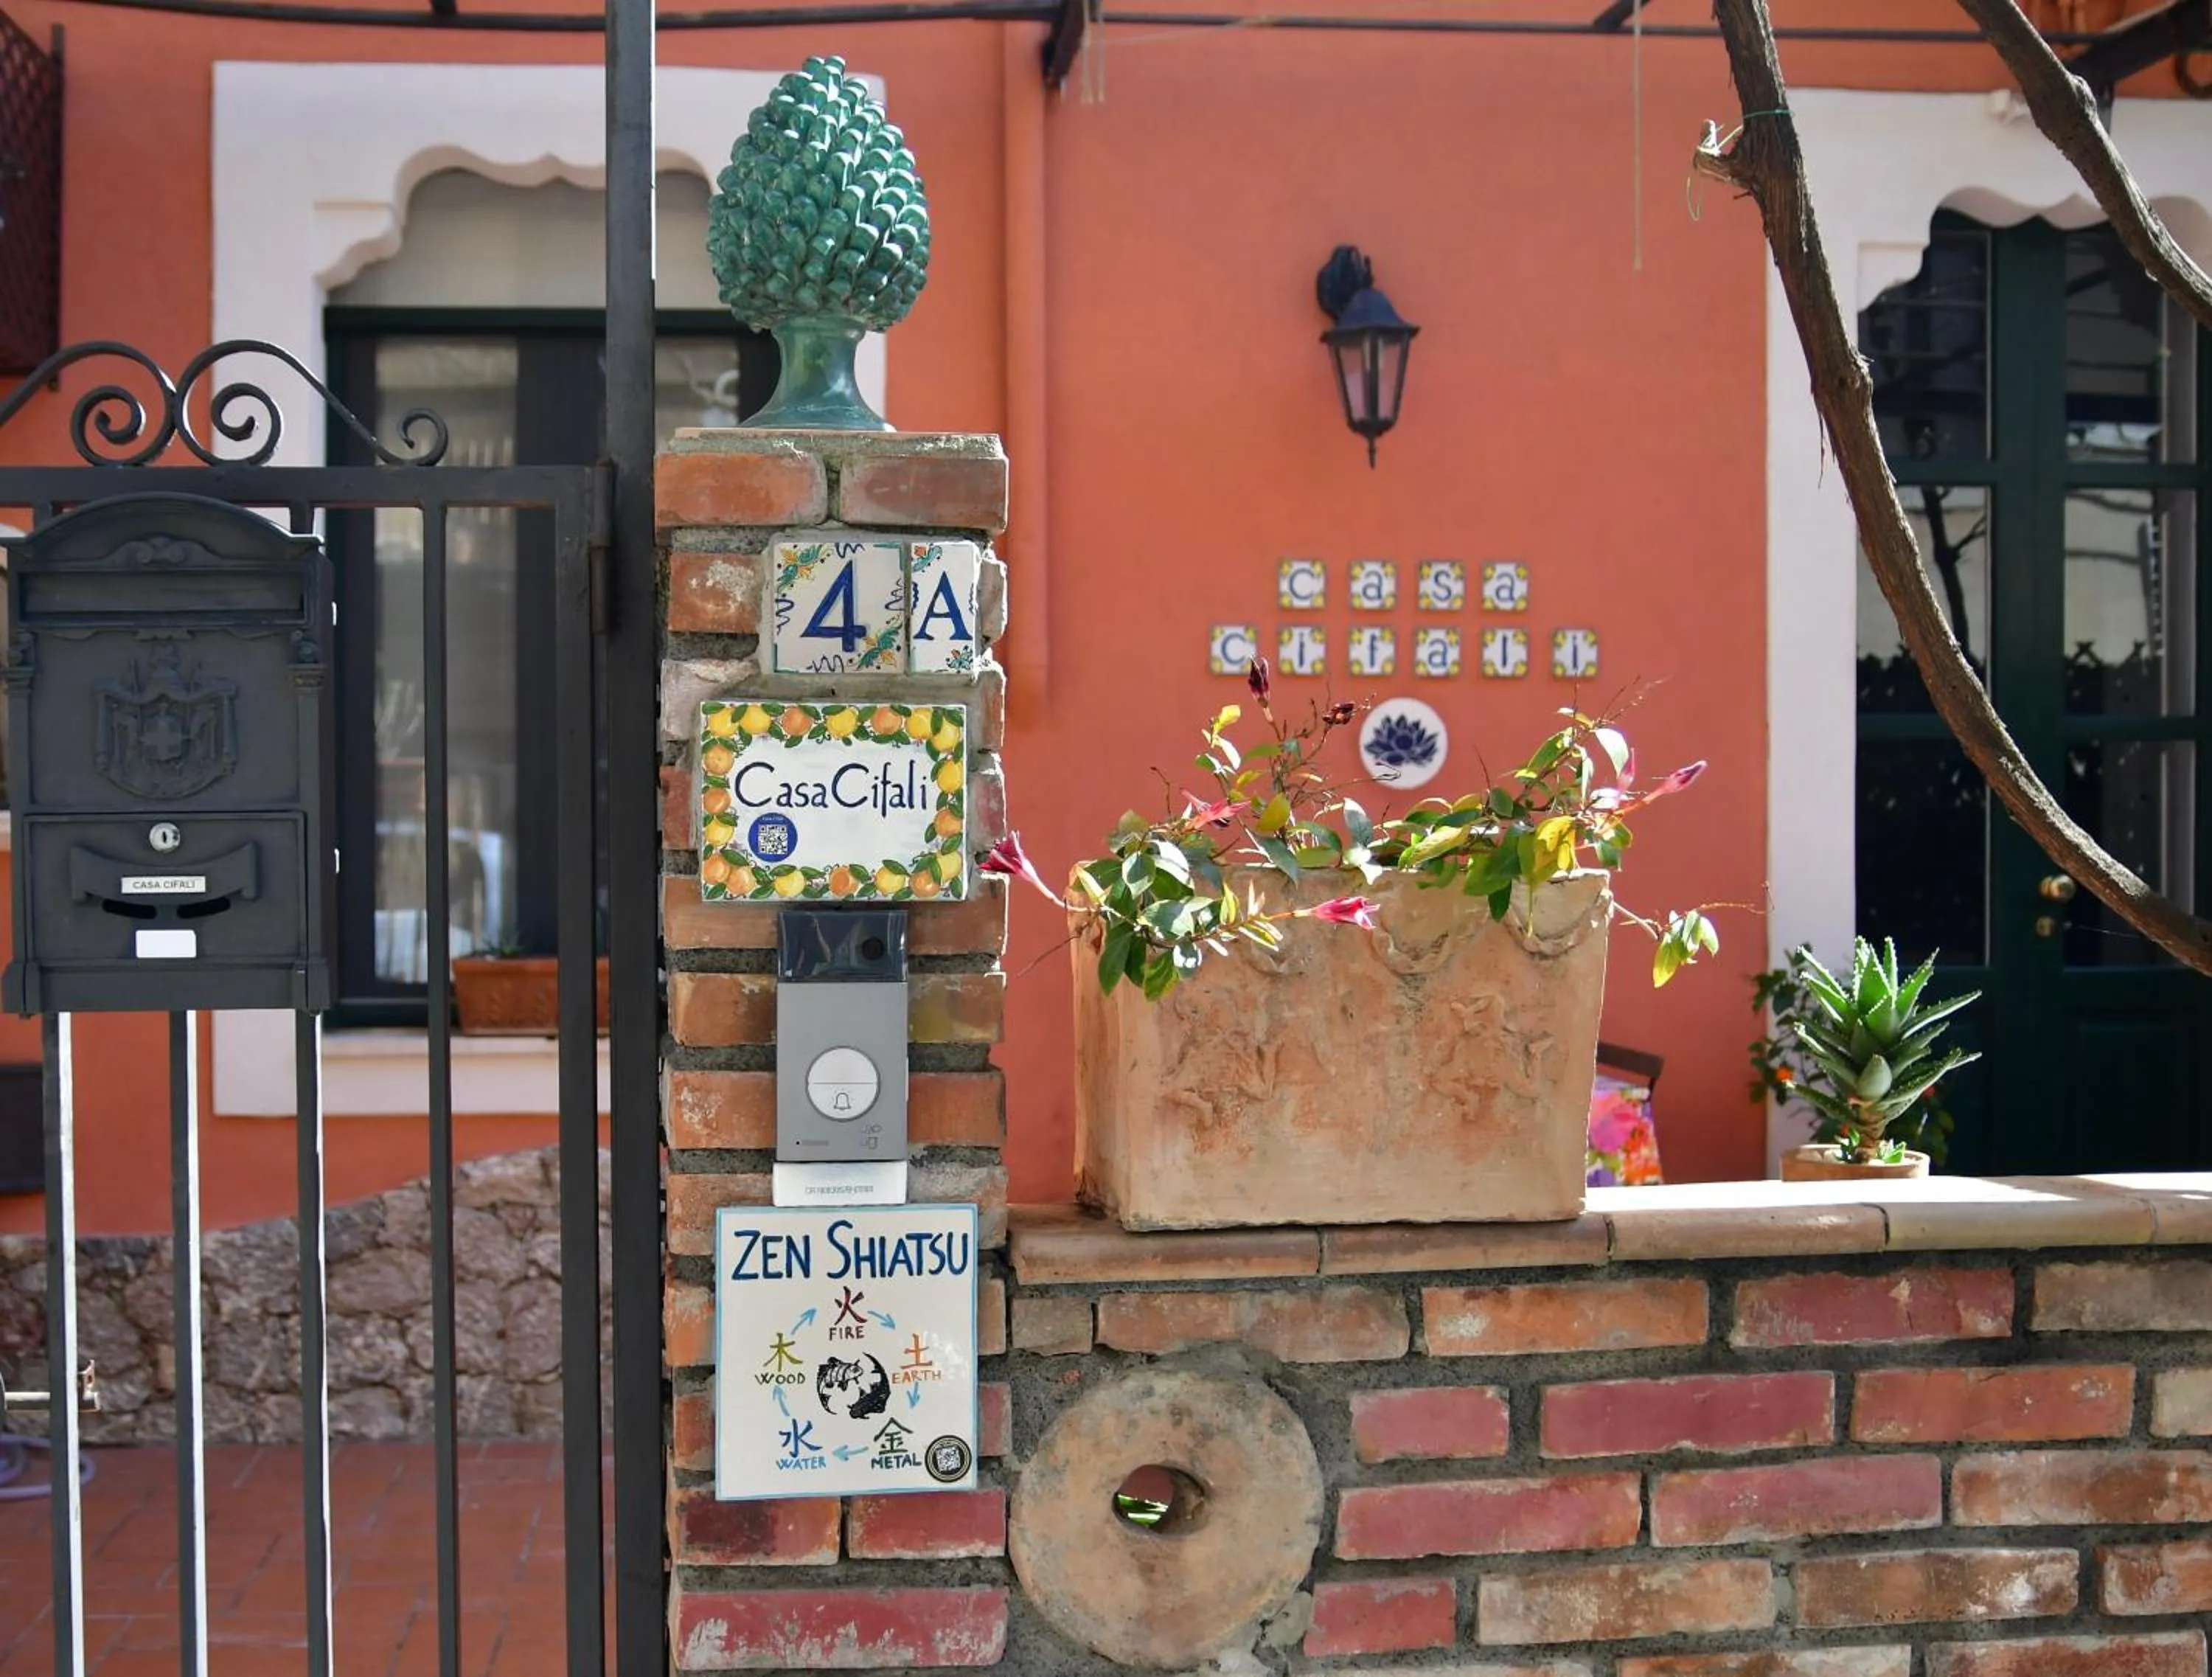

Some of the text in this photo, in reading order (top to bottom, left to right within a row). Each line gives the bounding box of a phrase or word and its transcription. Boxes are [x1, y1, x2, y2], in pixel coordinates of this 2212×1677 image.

[1288, 567, 1516, 603] Casa
[801, 559, 973, 653] 4 A
[1220, 632, 1579, 673] Cifali
[132, 880, 195, 889] CASA CIFALI
[731, 1220, 969, 1281] ZEN SHIATSU
[834, 1285, 868, 1326] 火
[828, 1325, 865, 1341] FIRE
[899, 1333, 933, 1369] 土
[762, 1333, 803, 1372] 木
[754, 1372, 806, 1385] WOOD
[891, 1369, 942, 1385] EARTH
[778, 1417, 823, 1459] 水
[873, 1417, 914, 1456] 金
[776, 1456, 827, 1471] WATER
[871, 1454, 922, 1470] METAL
